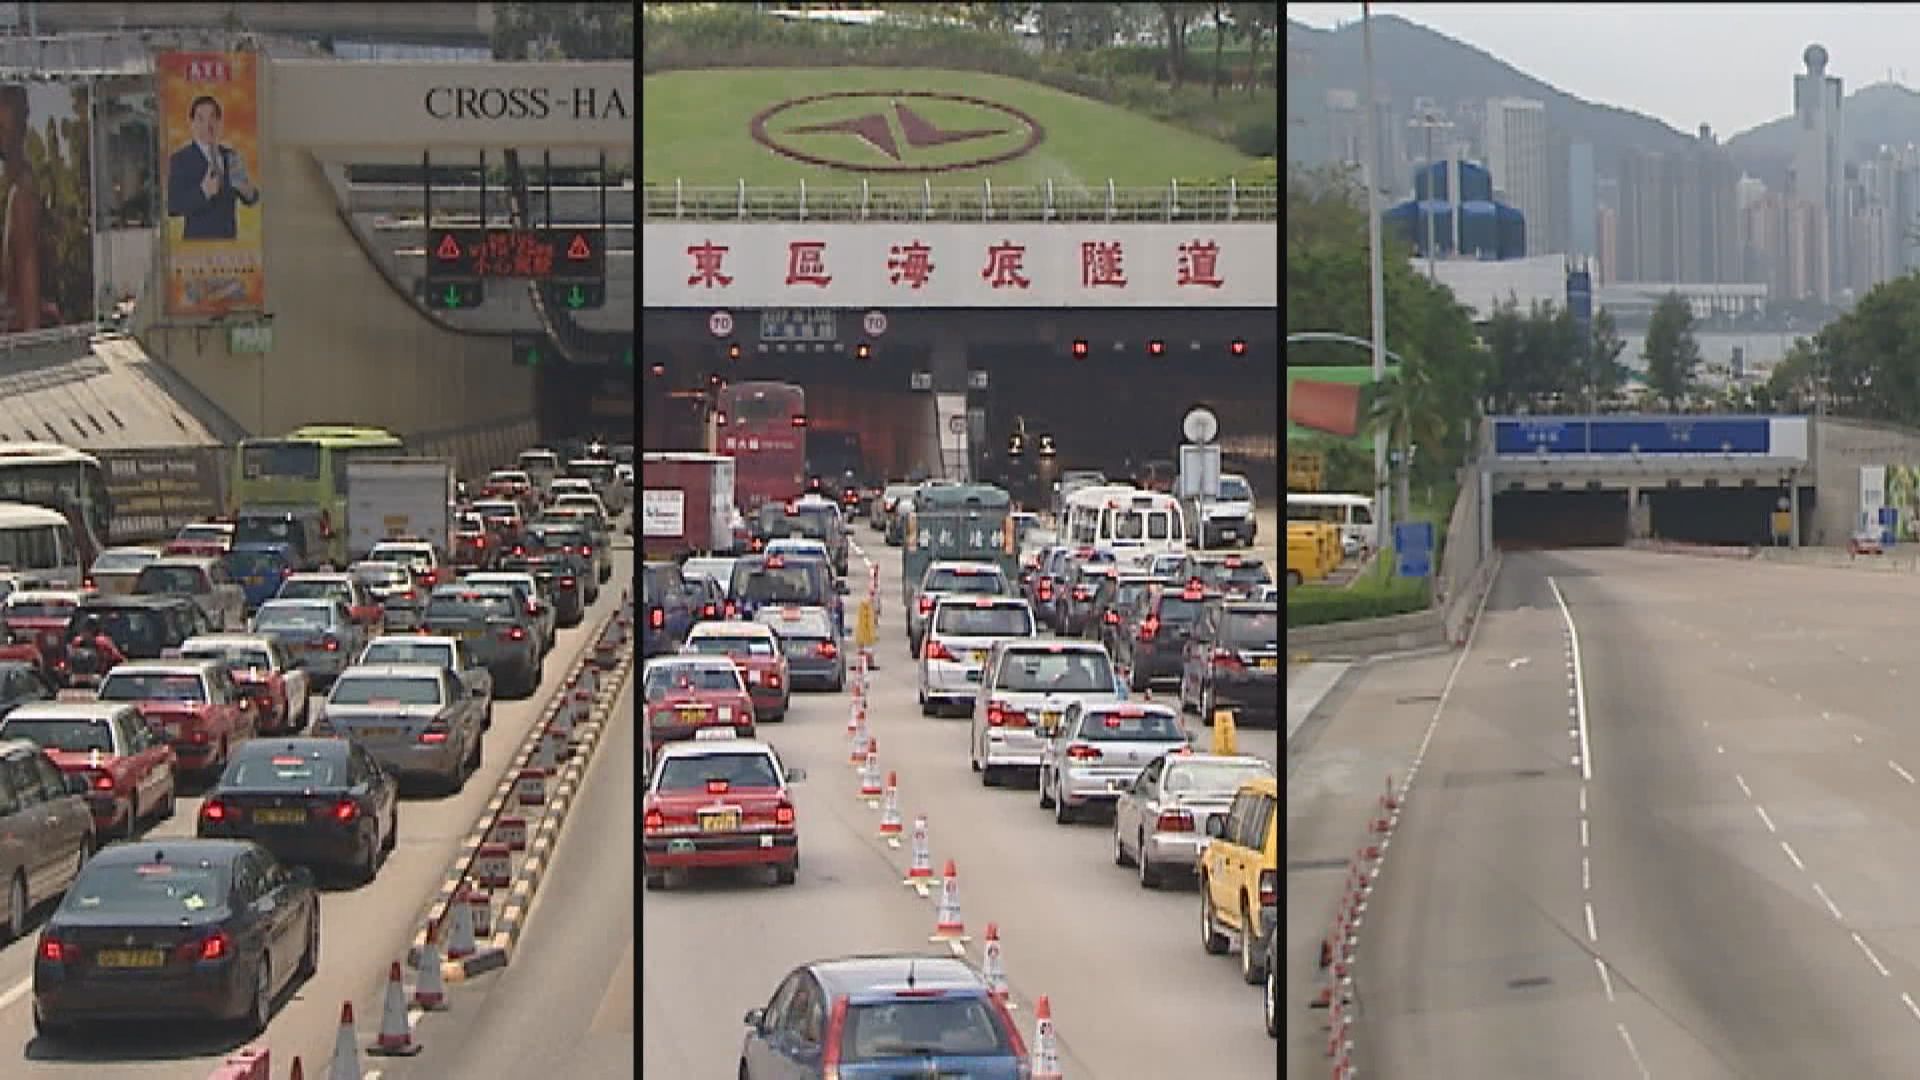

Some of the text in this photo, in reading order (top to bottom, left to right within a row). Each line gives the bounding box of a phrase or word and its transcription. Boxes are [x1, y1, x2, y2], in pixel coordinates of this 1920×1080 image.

[425, 87, 628, 119] CROSS-HA
[686, 240, 1225, 289] 東區海底隧道
